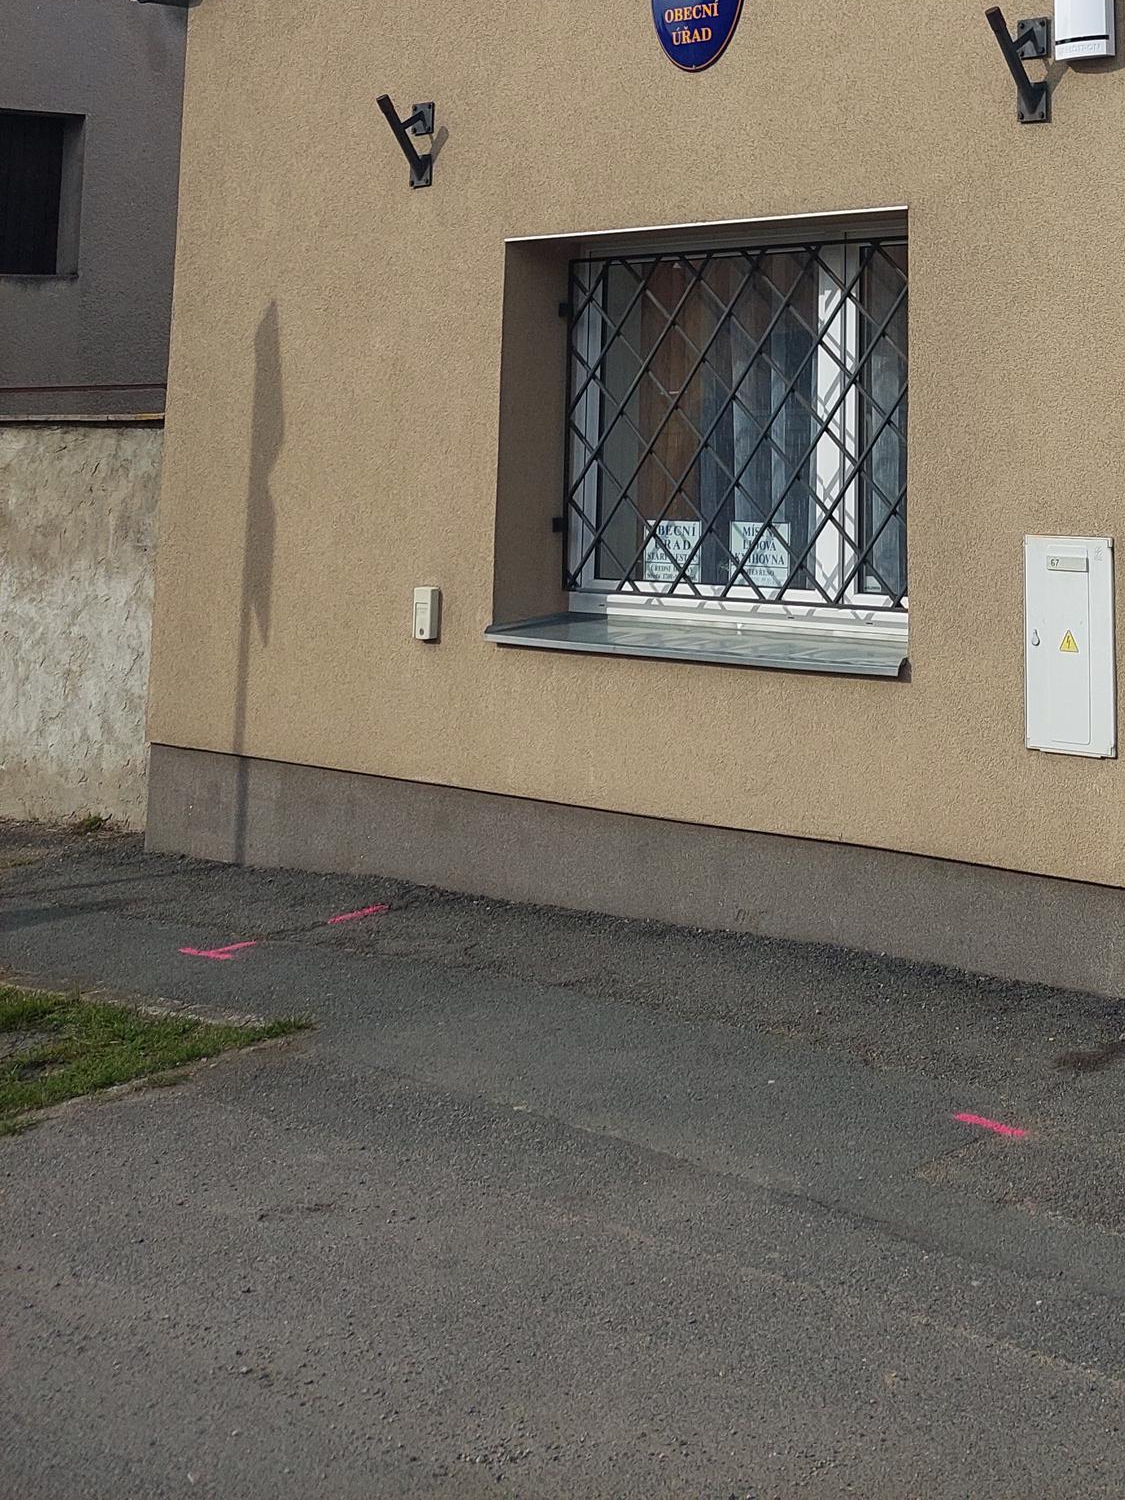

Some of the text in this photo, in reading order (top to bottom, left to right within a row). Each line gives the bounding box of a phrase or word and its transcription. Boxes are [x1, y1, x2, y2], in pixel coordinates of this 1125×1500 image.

[671, 25, 713, 46] ÚŘAD
[652, 523, 697, 537] BECNÍ
[1050, 558, 1060, 567] 67
